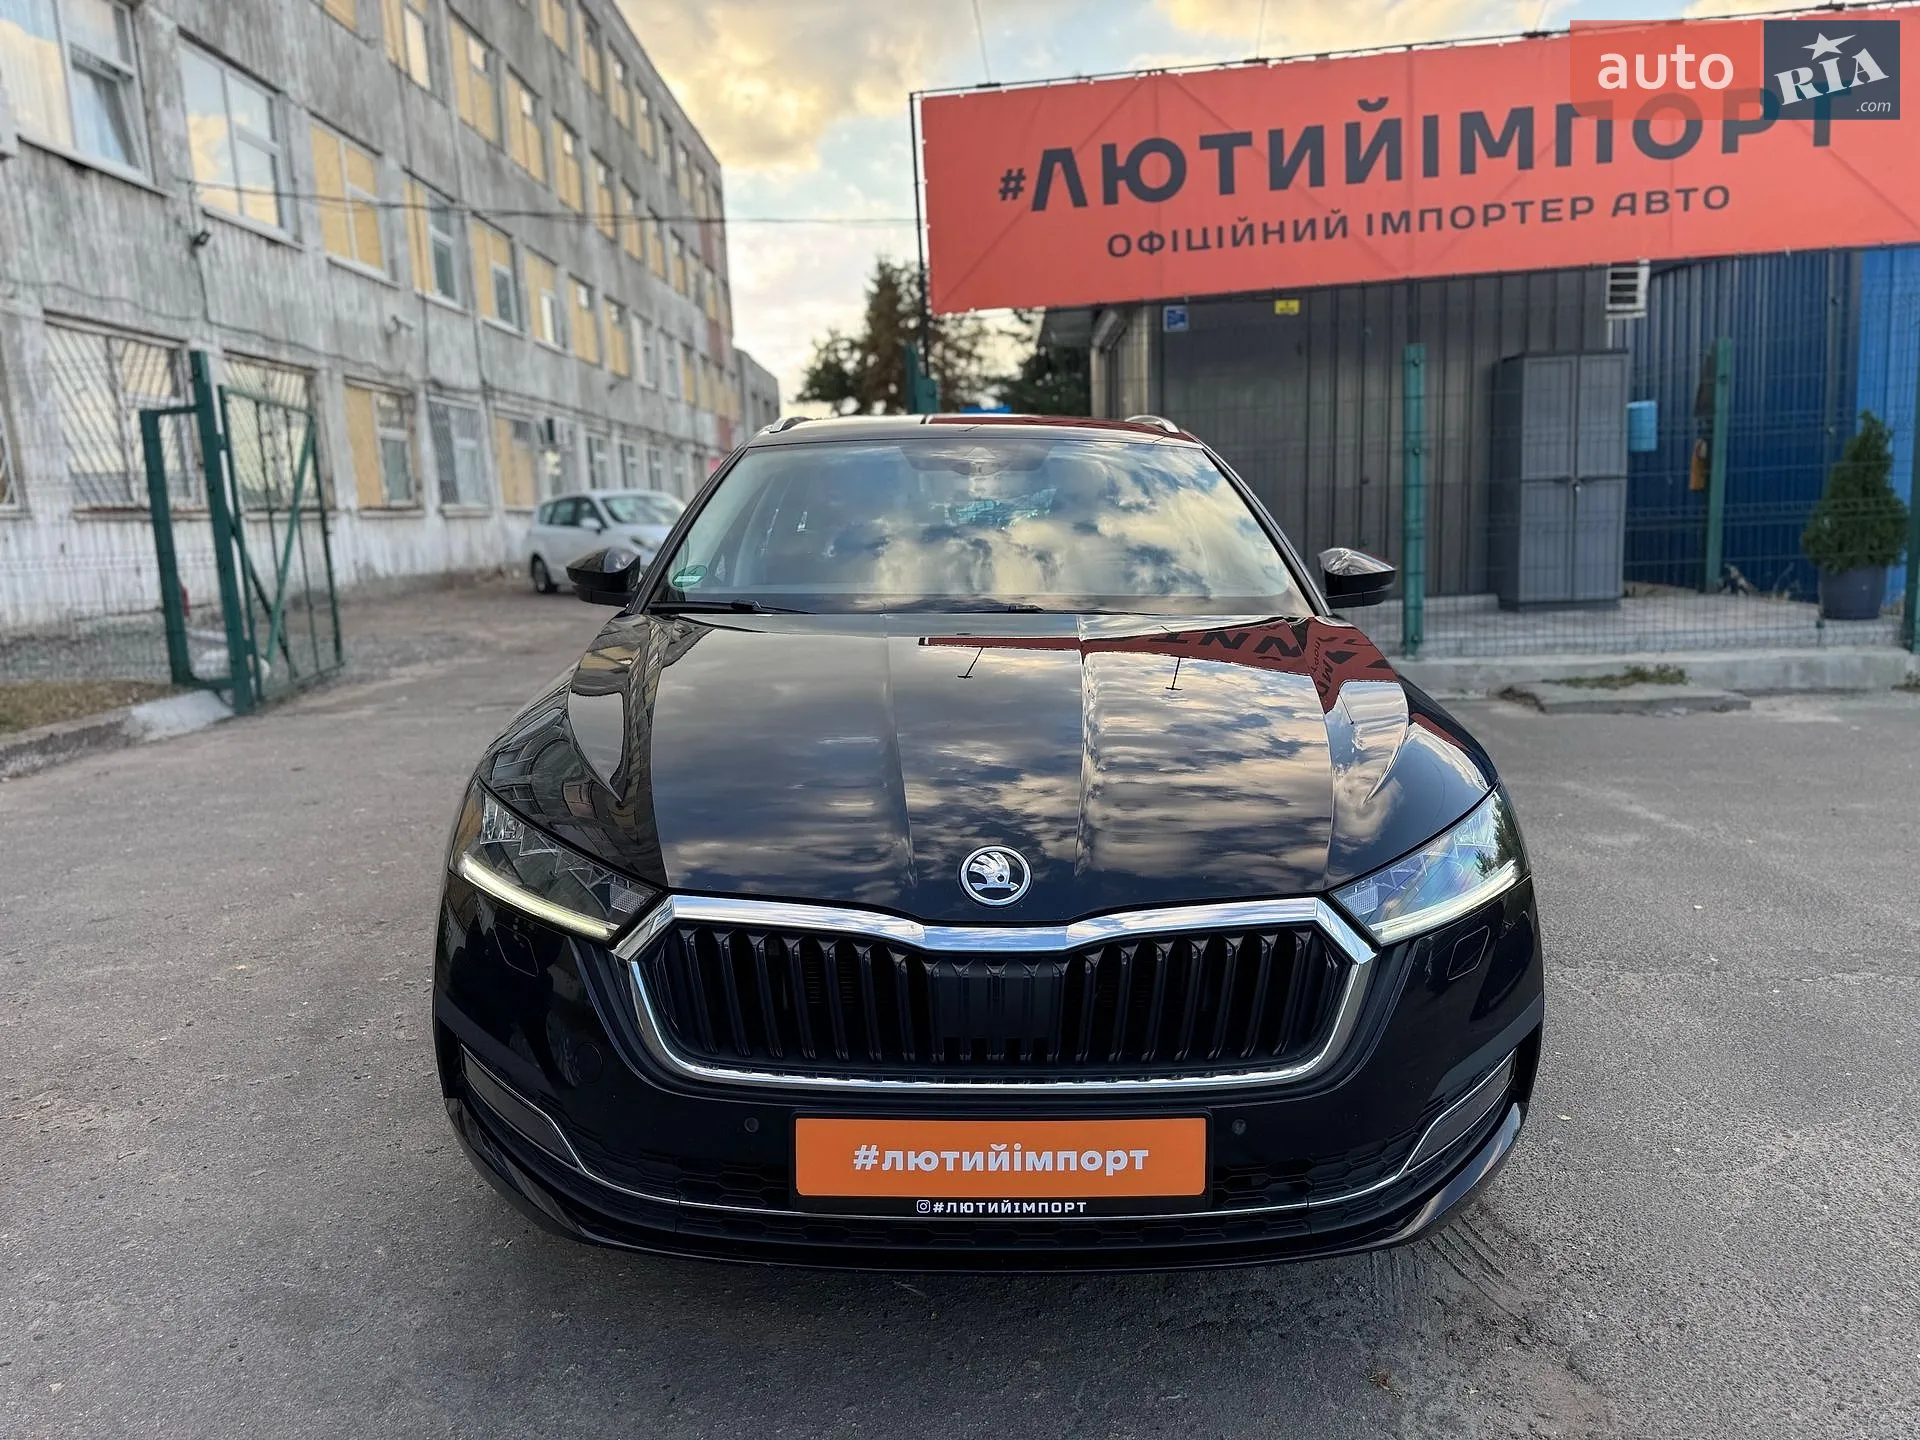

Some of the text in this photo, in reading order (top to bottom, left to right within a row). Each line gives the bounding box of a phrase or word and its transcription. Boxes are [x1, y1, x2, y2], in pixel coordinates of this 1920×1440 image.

[1107, 185, 1731, 258] ОФІЦІЙНИЙ ІМПОРТЕР АВТО
[853, 1143, 1149, 1176] #лютийімпорт
[932, 1200, 1088, 1214] #ЛЮТИЙІМПОРТ
